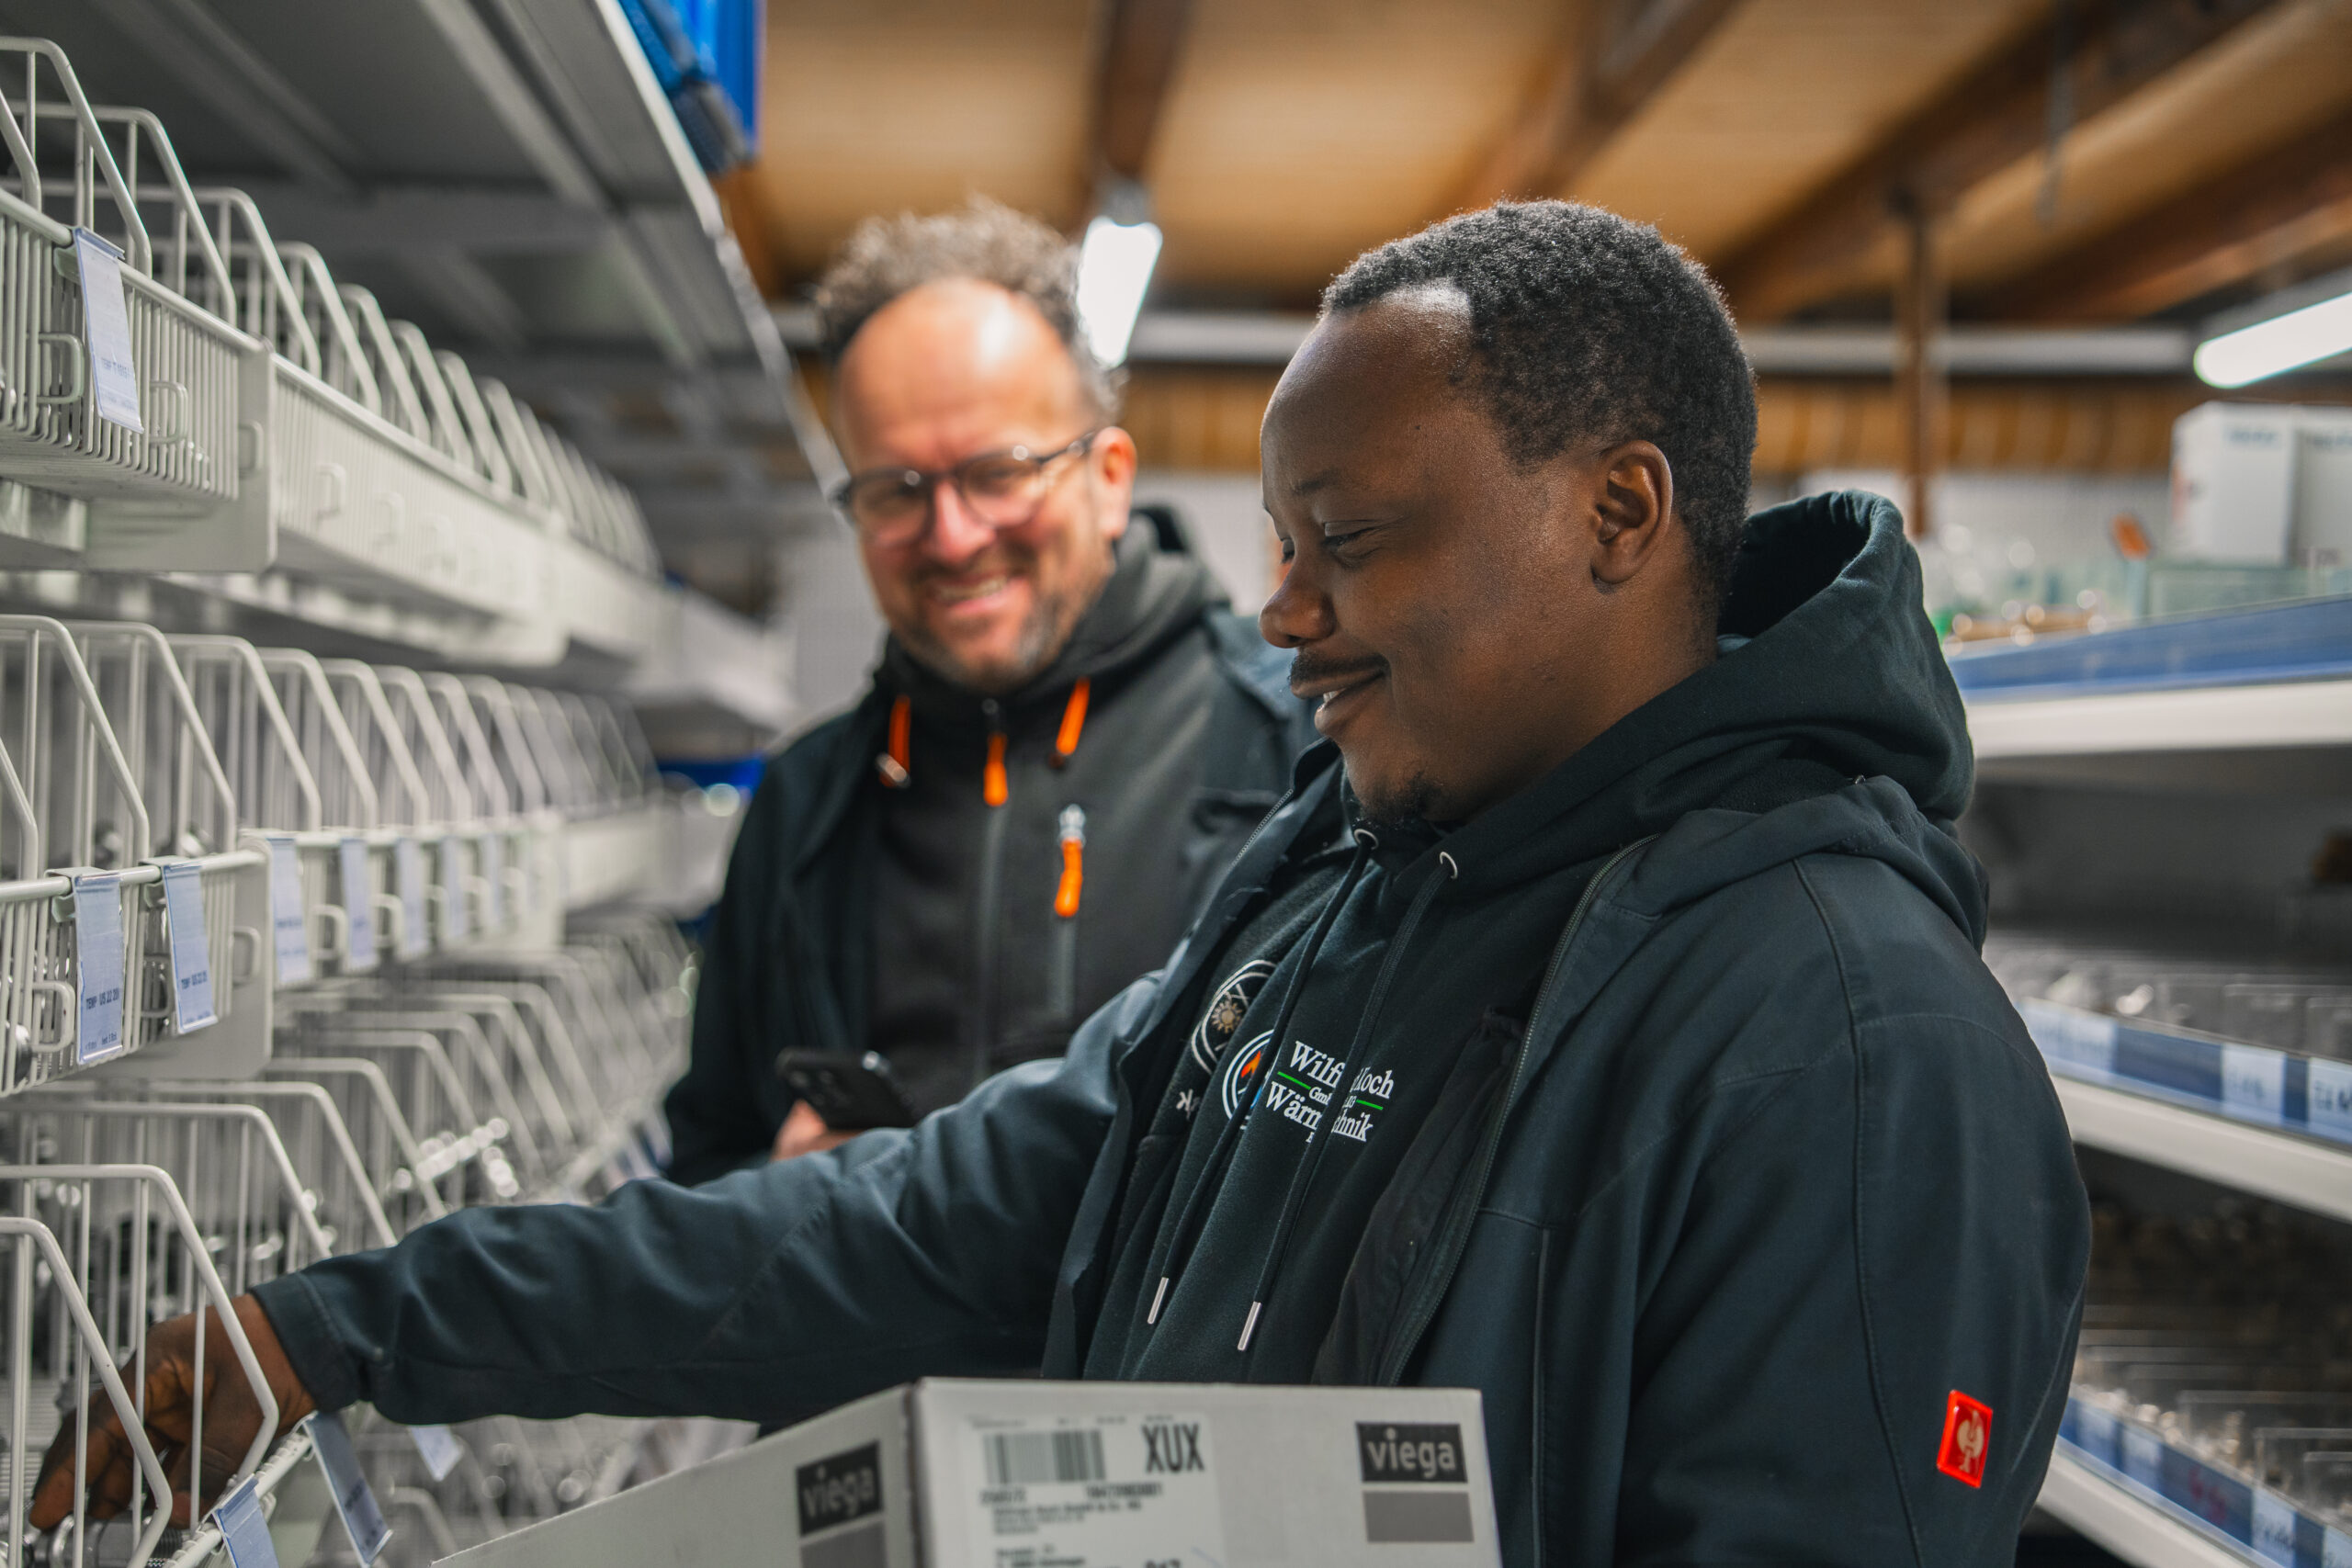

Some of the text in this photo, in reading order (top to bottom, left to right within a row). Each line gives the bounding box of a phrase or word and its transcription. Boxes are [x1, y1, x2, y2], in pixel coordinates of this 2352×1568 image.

[1142, 1424, 1205, 1473] XUX
[1366, 1427, 1457, 1480] viega
[803, 1464, 875, 1518] viega
